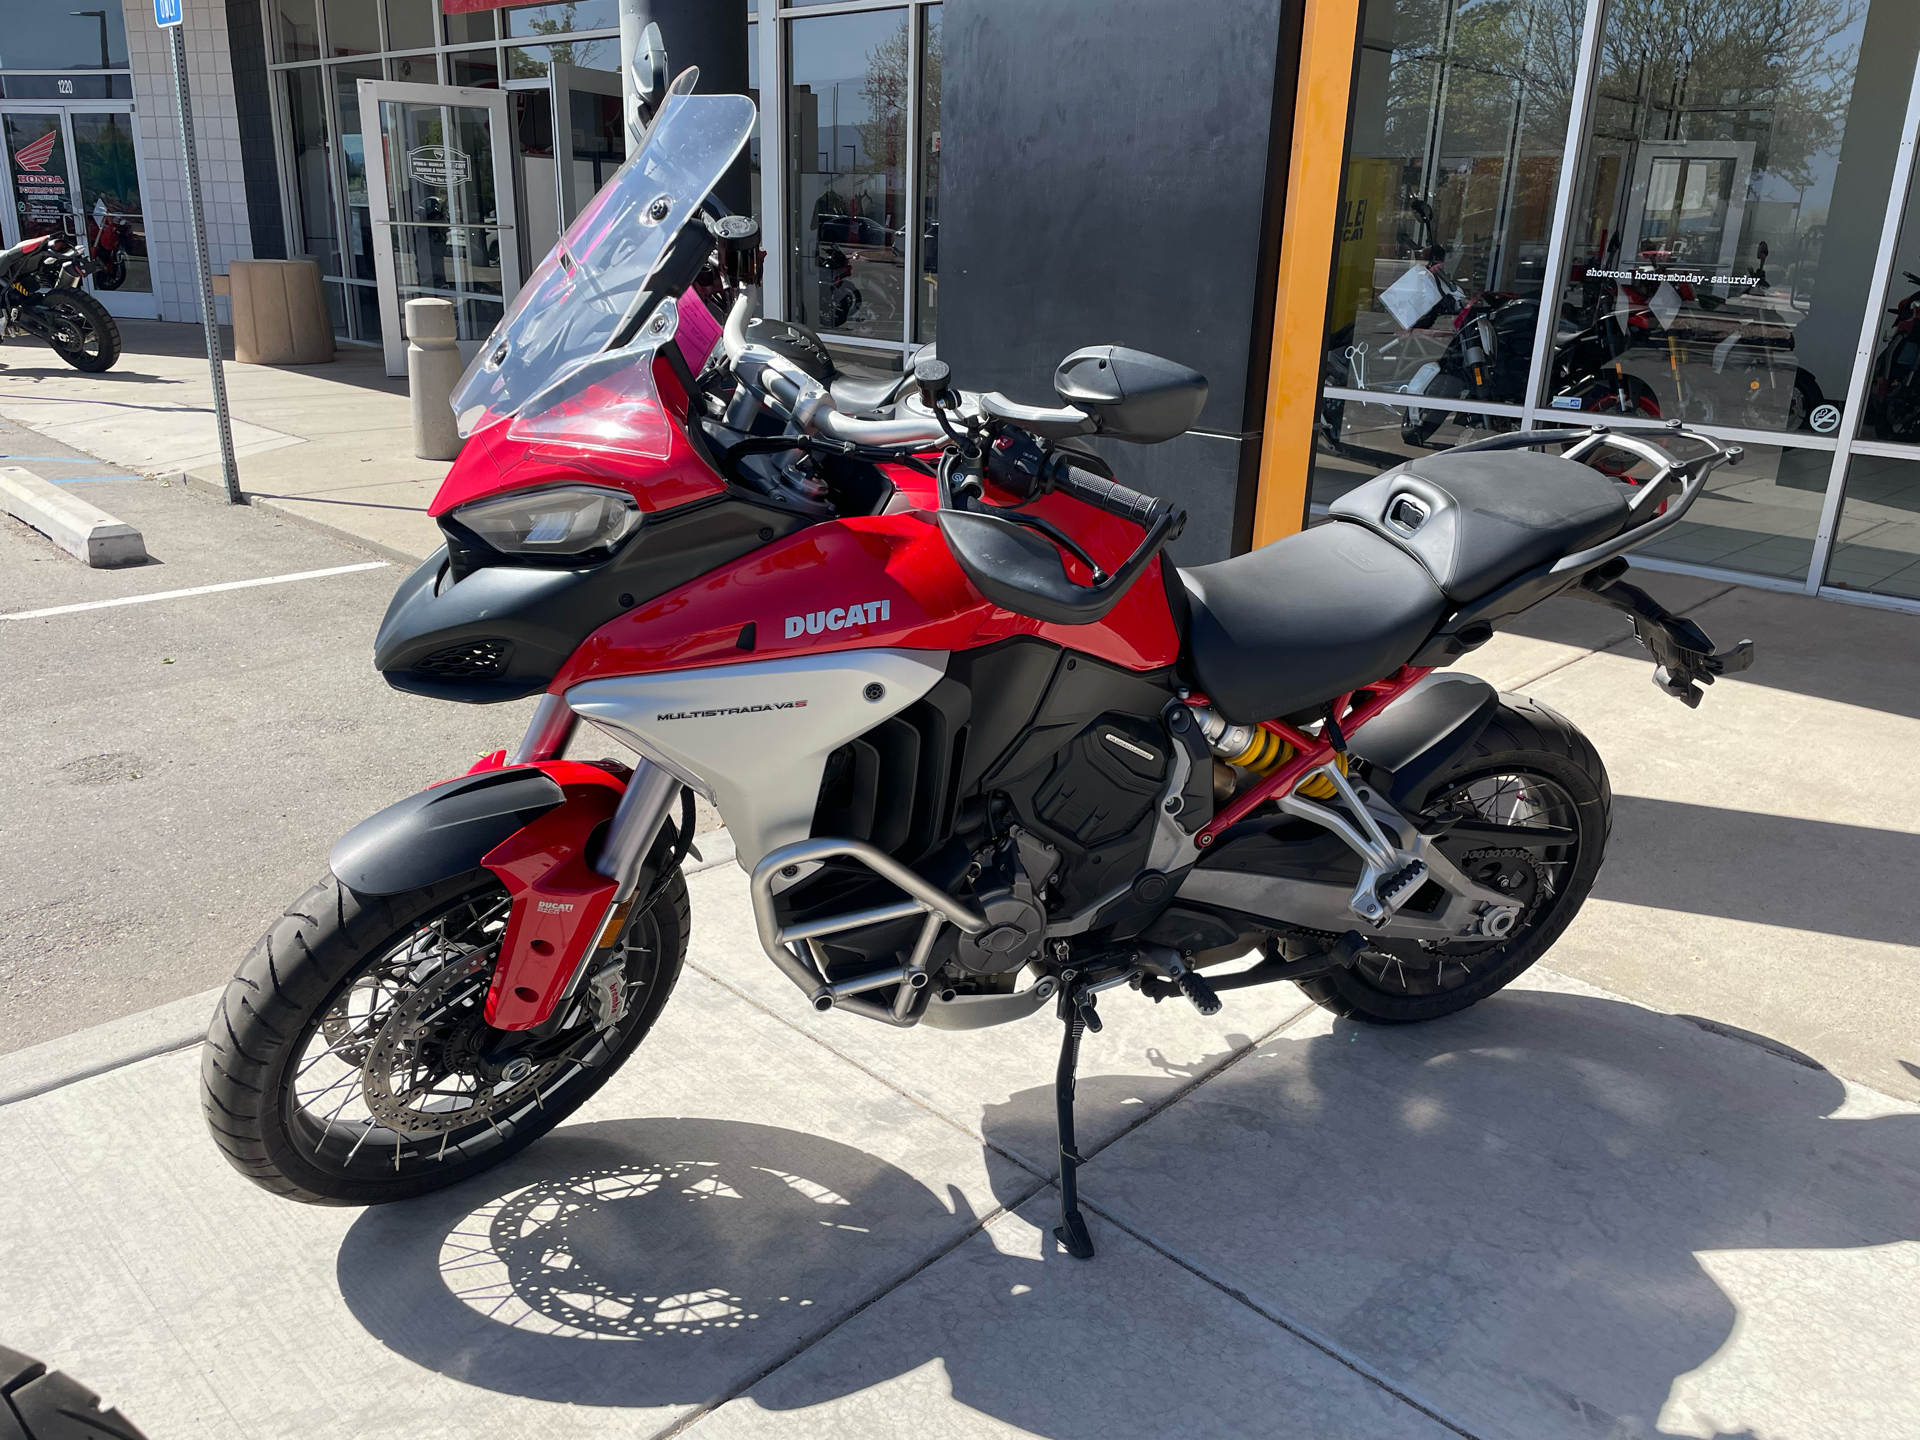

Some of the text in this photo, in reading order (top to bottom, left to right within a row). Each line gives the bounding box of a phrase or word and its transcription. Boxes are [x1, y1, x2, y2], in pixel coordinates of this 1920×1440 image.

[57, 79, 73, 94] 1220
[17, 174, 65, 185] HONDA
[19, 186, 66, 195] POWERSPORTS
[1586, 267, 1632, 280] showroom
[1710, 274, 1761, 288] saturday
[784, 599, 890, 639] DUCATI
[538, 900, 574, 910] DUCATI
[609, 982, 621, 1014] brembo
